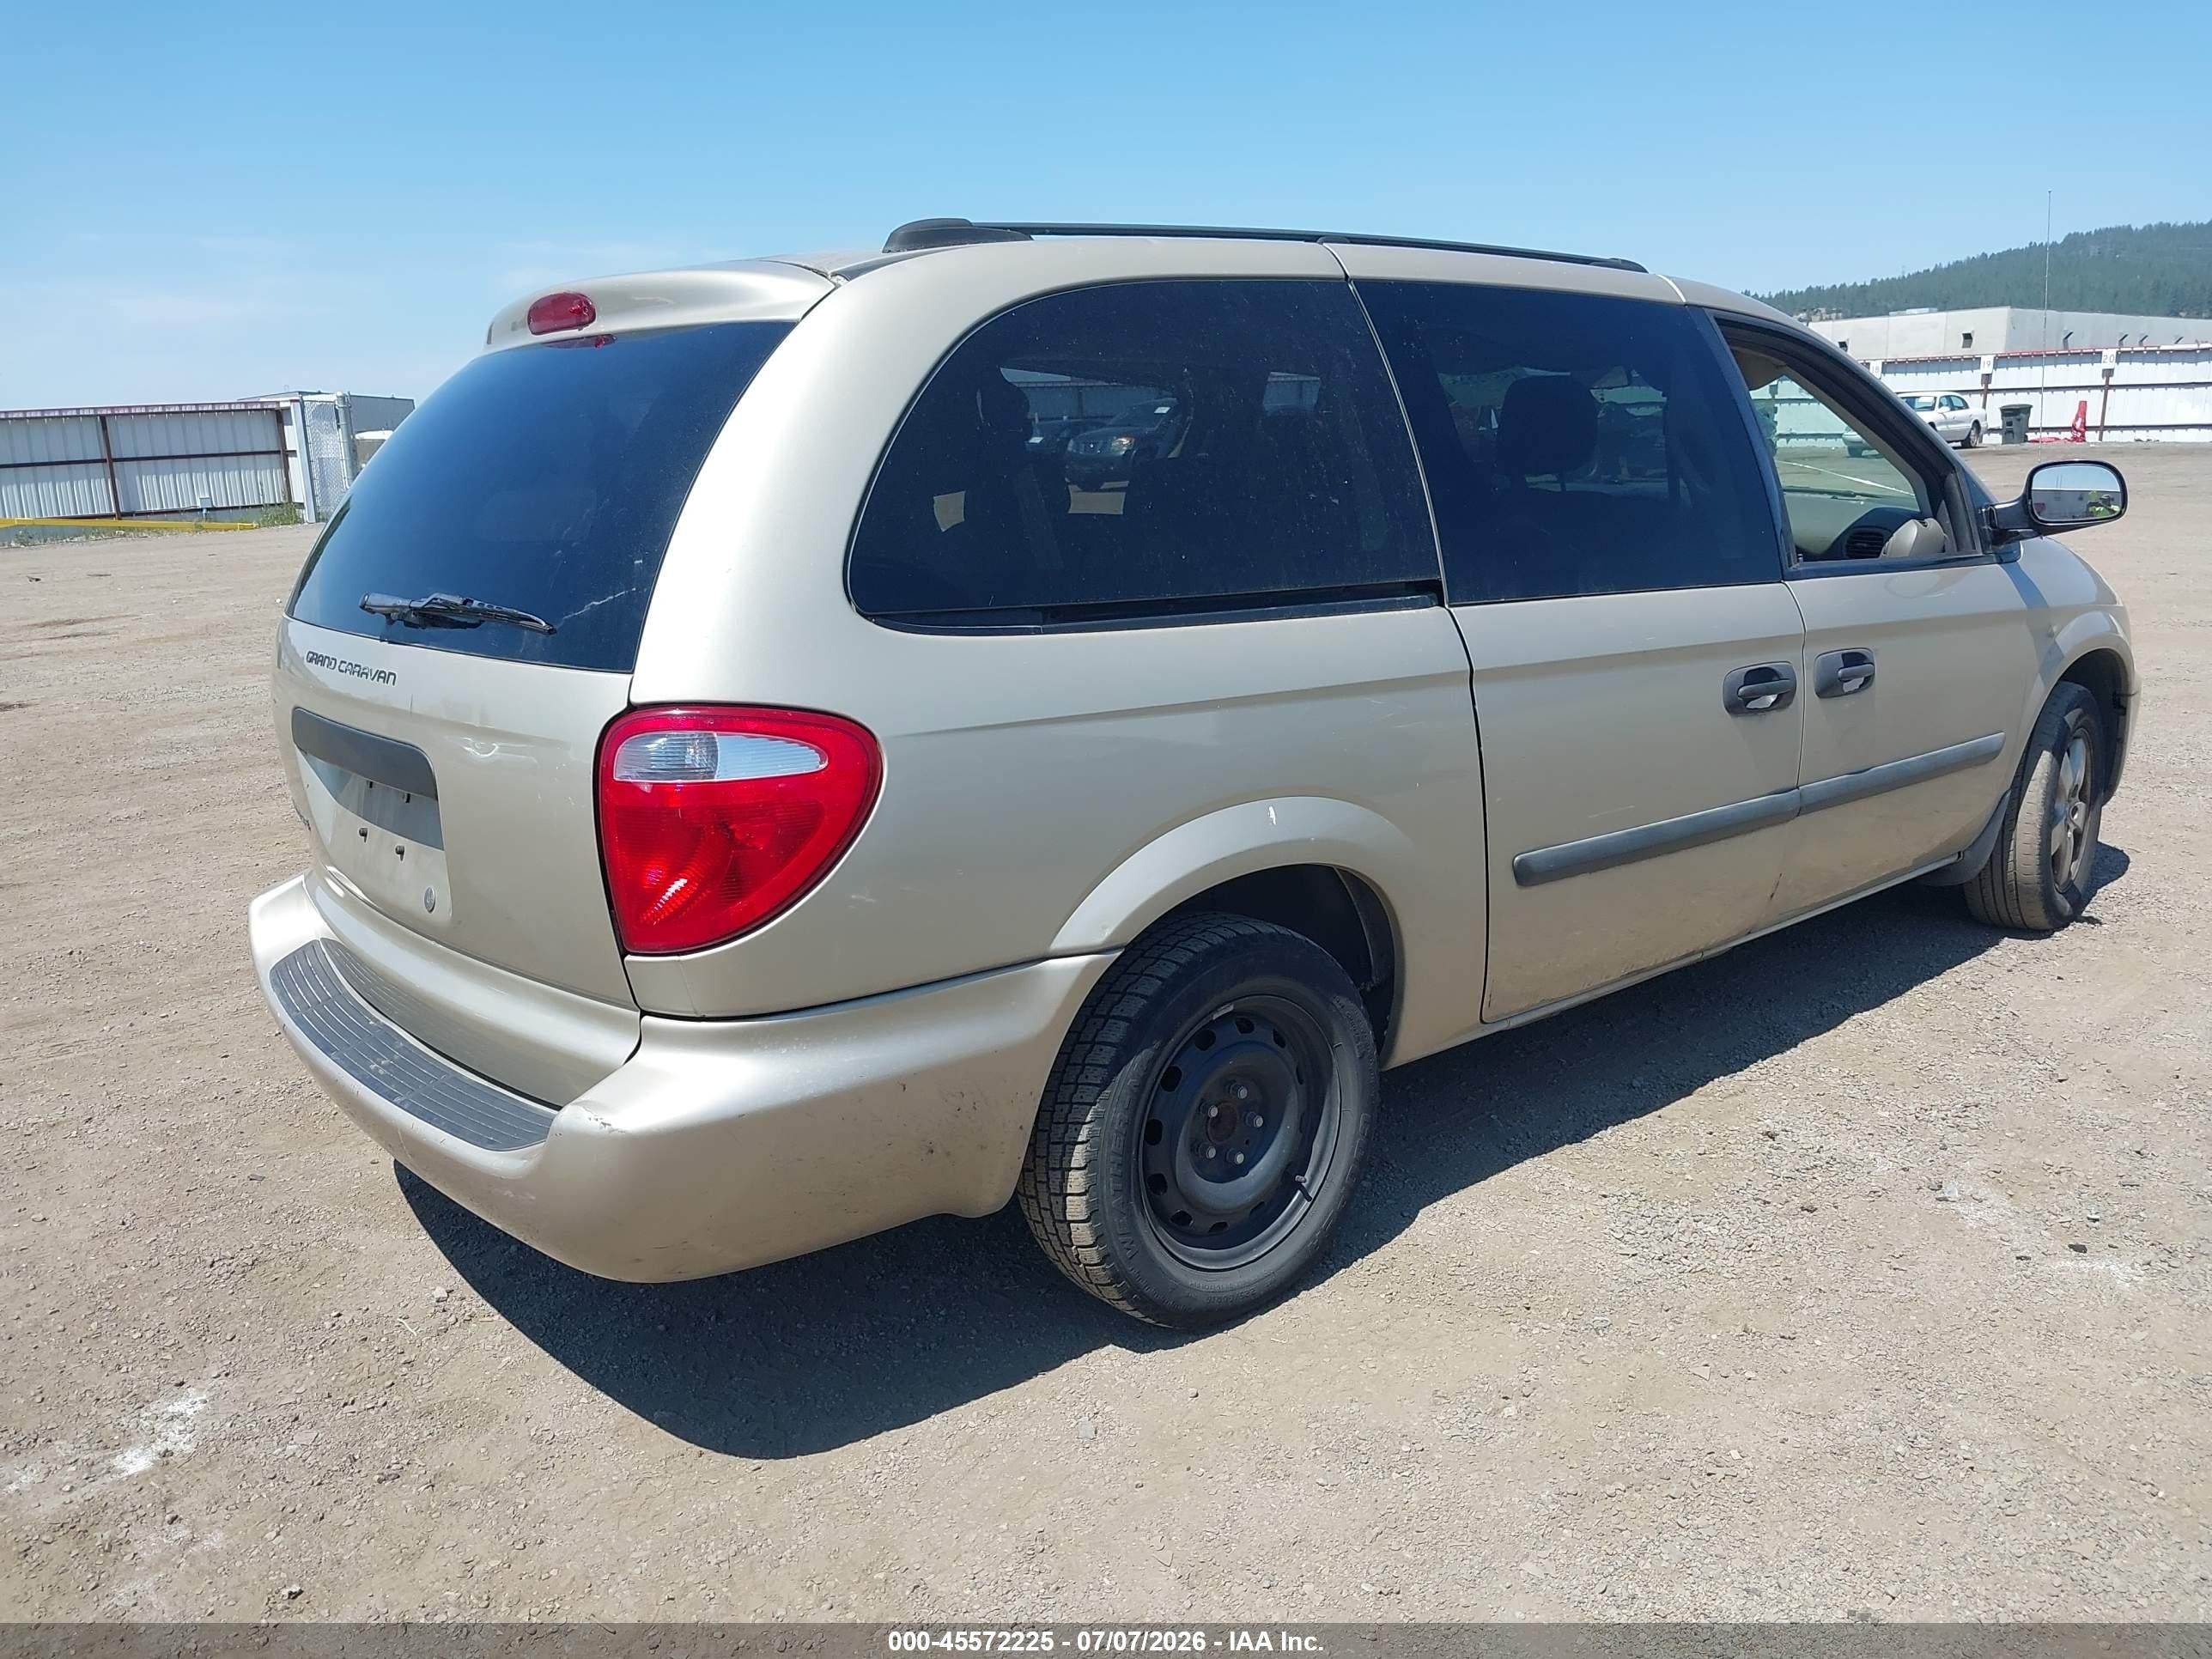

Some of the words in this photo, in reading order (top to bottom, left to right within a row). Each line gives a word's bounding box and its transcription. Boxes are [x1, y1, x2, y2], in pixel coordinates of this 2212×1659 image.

[2103, 354, 2115, 363] 20
[306, 650, 337, 670] GRAND
[338, 659, 397, 686] CARAVAN
